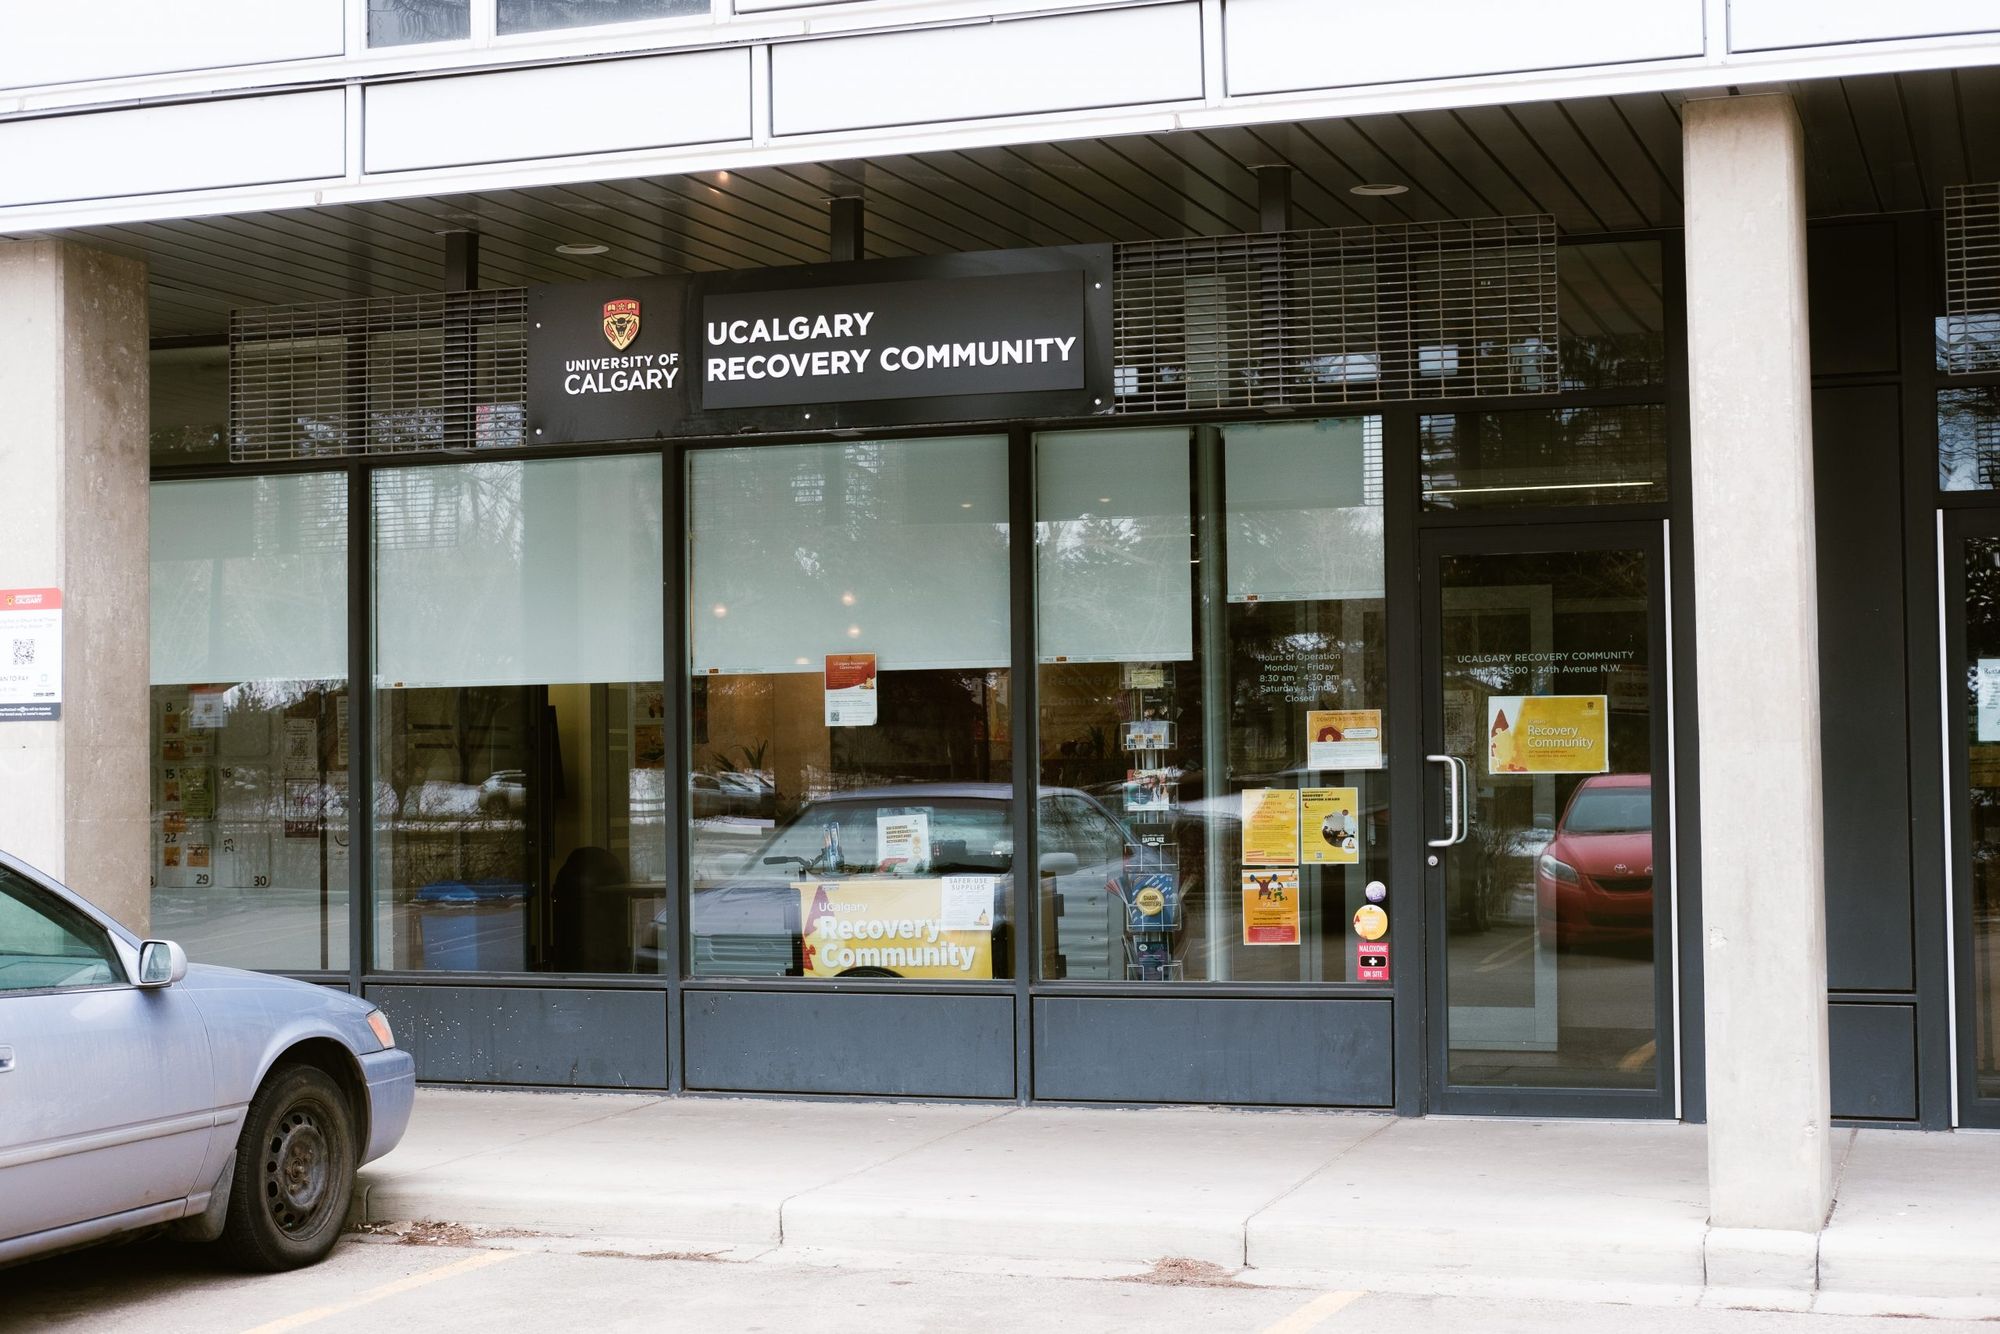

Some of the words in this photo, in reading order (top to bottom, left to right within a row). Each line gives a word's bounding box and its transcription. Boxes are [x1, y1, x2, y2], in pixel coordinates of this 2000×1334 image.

[707, 312, 874, 346] UCALGARY
[566, 354, 654, 372] UNIVERSITY
[658, 353, 679, 366] OF
[707, 348, 871, 382] RECOVERY
[879, 336, 1077, 372] COMMUNITY
[564, 367, 679, 395] CALGARY
[1258, 654, 1284, 662] Hours
[1285, 653, 1294, 661] of
[1297, 652, 1341, 663] Operation
[1457, 654, 1511, 664] UCALGARY
[1514, 652, 1568, 662] RECOVERY
[1572, 650, 1634, 661] COMMUNITY
[1264, 664, 1298, 672] Monday
[1307, 663, 1335, 672] Friday
[1470, 667, 1489, 676] Unit
[1503, 666, 1528, 675] 3500
[1537, 665, 1560, 675] 24th
[1562, 665, 1598, 674] Avenue
[1600, 664, 1622, 673] N.W.
[1259, 674, 1279, 682] 8:30
[1303, 674, 1323, 682] 4:30
[1325, 675, 1340, 684] pm
[1260, 684, 1298, 694] Saturday
[1308, 684, 1339, 693] Sunday
[1285, 694, 1315, 702] Closed
[166, 702, 173, 712] 8
[1527, 725, 1578, 738] Recovery
[1527, 736, 1594, 750] Community
[165, 769, 175, 780] 15
[221, 768, 231, 778] 16
[164, 833, 176, 843] 22
[224, 838, 234, 853] 23
[196, 874, 208, 884] 29
[254, 875, 266, 886] 30
[819, 902, 867, 913] UCalgary
[821, 915, 940, 944] Recovery
[1359, 945, 1387, 953] NALOXONE
[821, 942, 976, 971] Community
